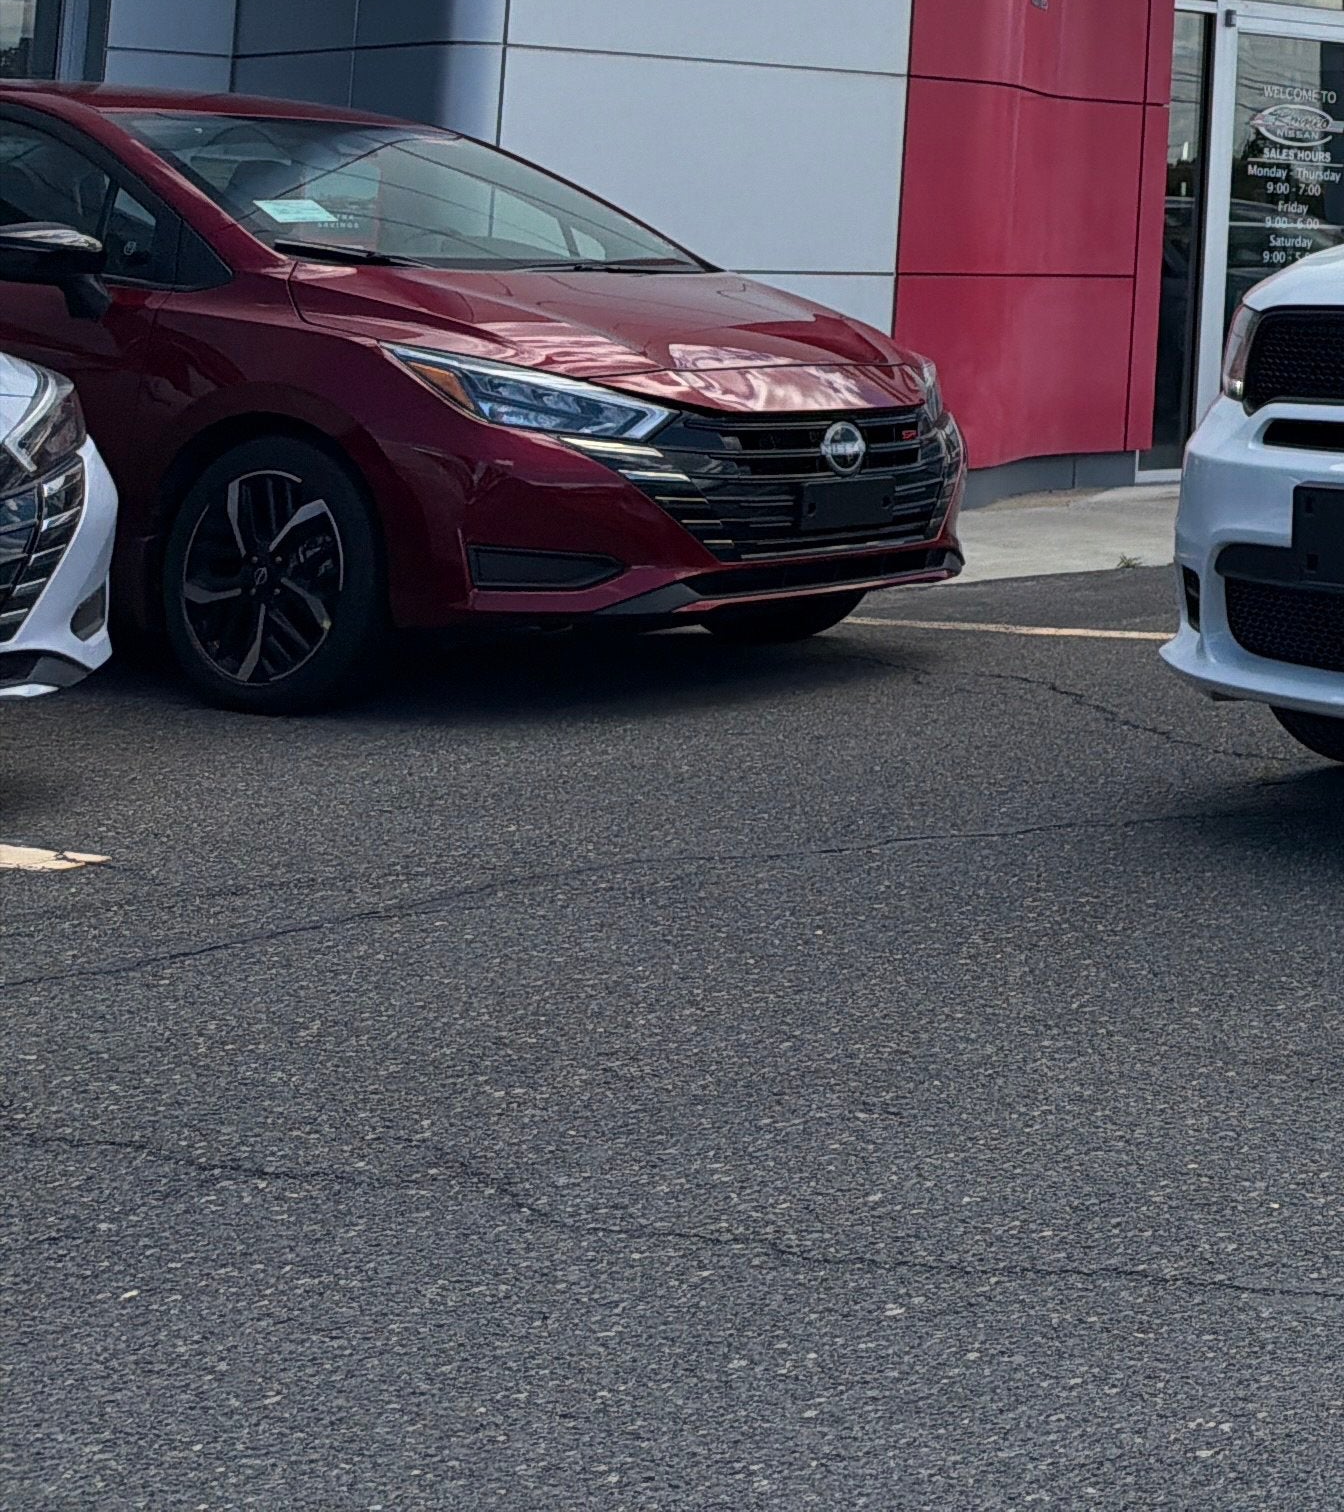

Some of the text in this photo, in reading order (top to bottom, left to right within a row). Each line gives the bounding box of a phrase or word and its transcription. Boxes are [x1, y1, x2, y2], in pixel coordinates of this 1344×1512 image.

[1263, 85, 1337, 104] WELCOME TO
[1276, 129, 1319, 140] NISSAN
[1263, 147, 1331, 163] SALES HOURS
[1247, 164, 1288, 180] Monday
[1296, 167, 1341, 184] Thursday
[1266, 181, 1290, 194] 9:00
[1299, 183, 1321, 196] 7:00
[1277, 200, 1309, 216] Friday
[1265, 216, 1288, 229] 9:00
[1296, 217, 1320, 230] 6:00
[1269, 234, 1313, 249] Saturday
[1262, 250, 1286, 263] 9:00
